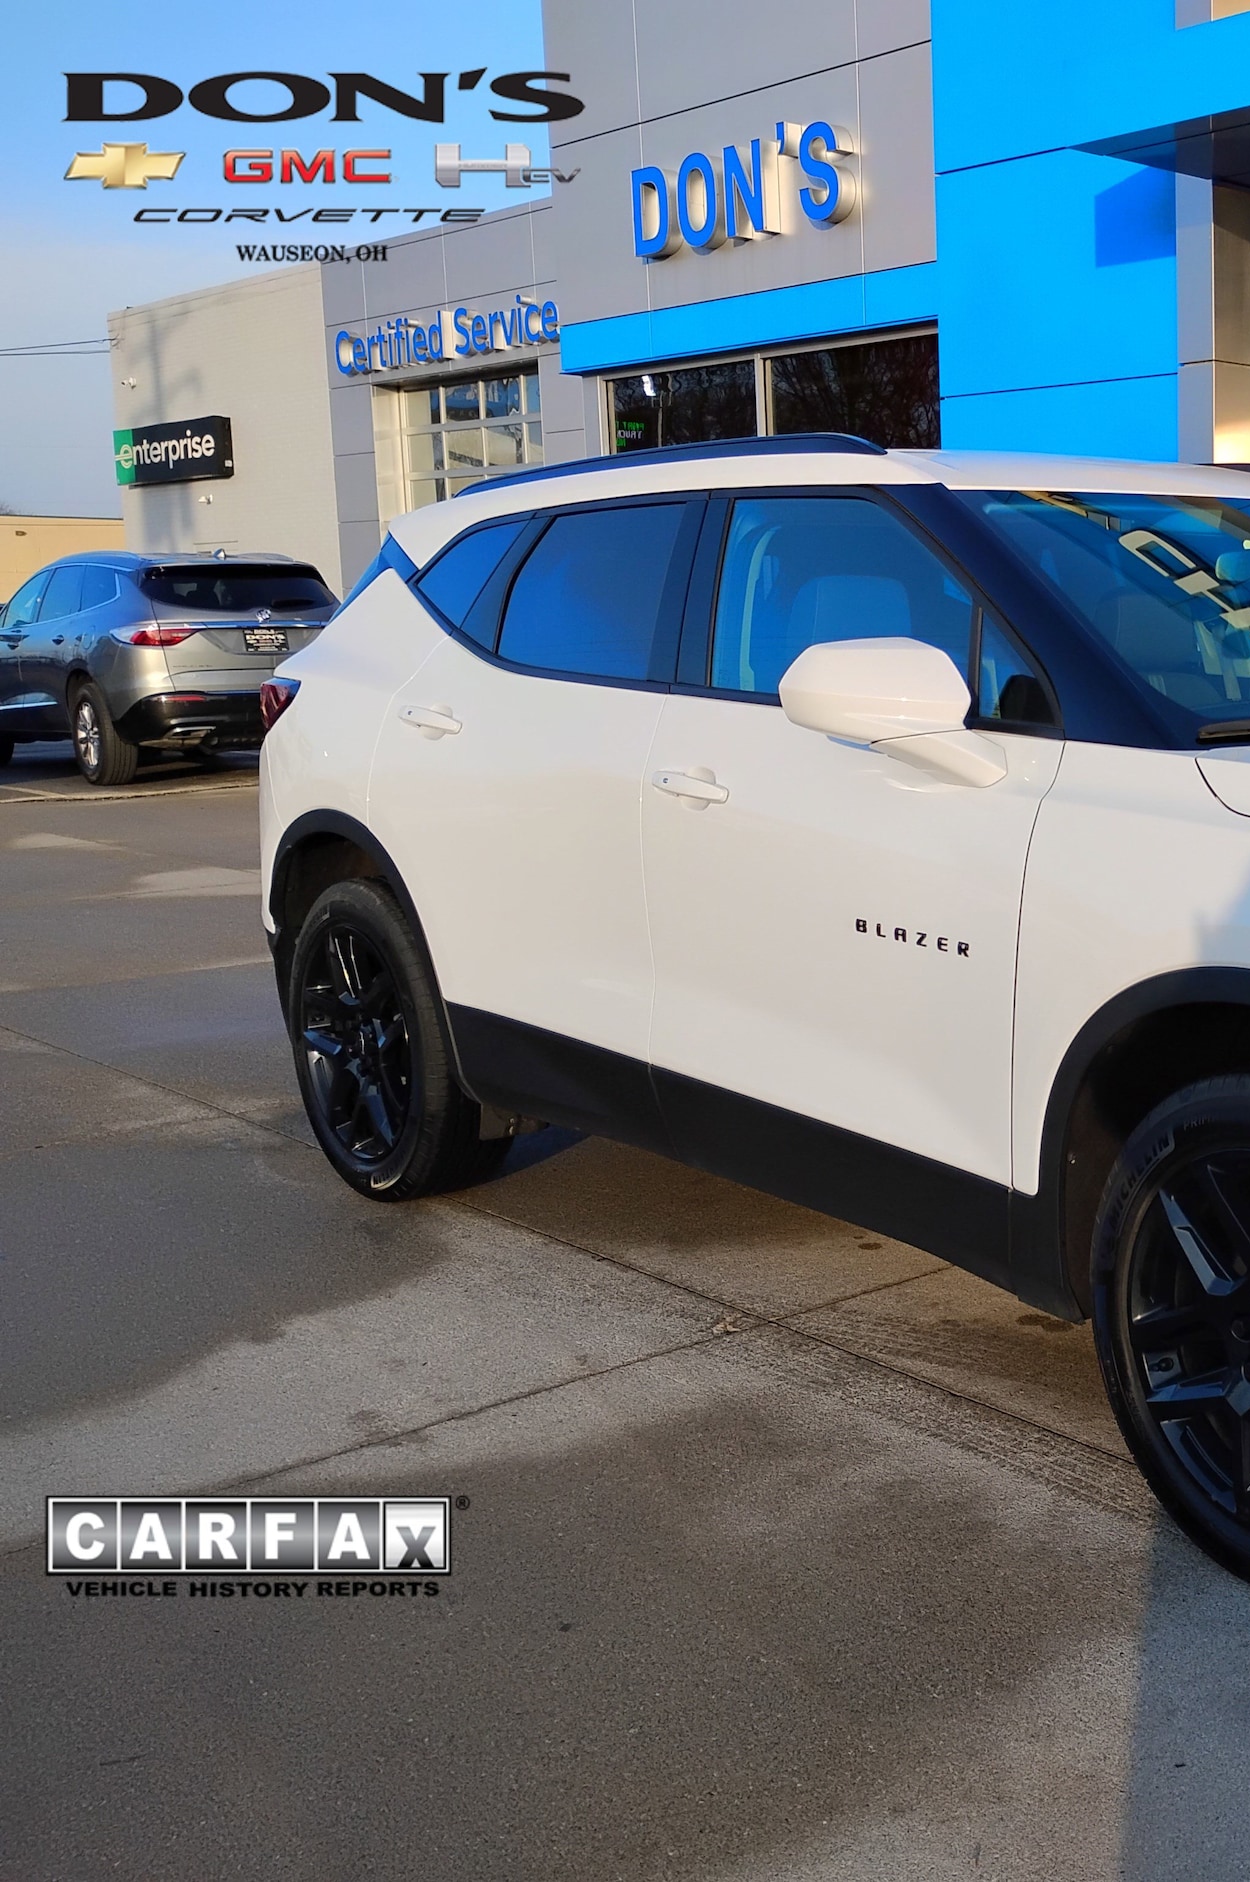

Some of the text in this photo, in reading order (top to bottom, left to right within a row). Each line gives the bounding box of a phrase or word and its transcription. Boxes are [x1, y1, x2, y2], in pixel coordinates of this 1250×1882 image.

[630, 121, 842, 258] DON'S
[335, 294, 560, 376] Certified Service
[115, 429, 215, 469] enterprise
[855, 918, 970, 958] BLAZER
